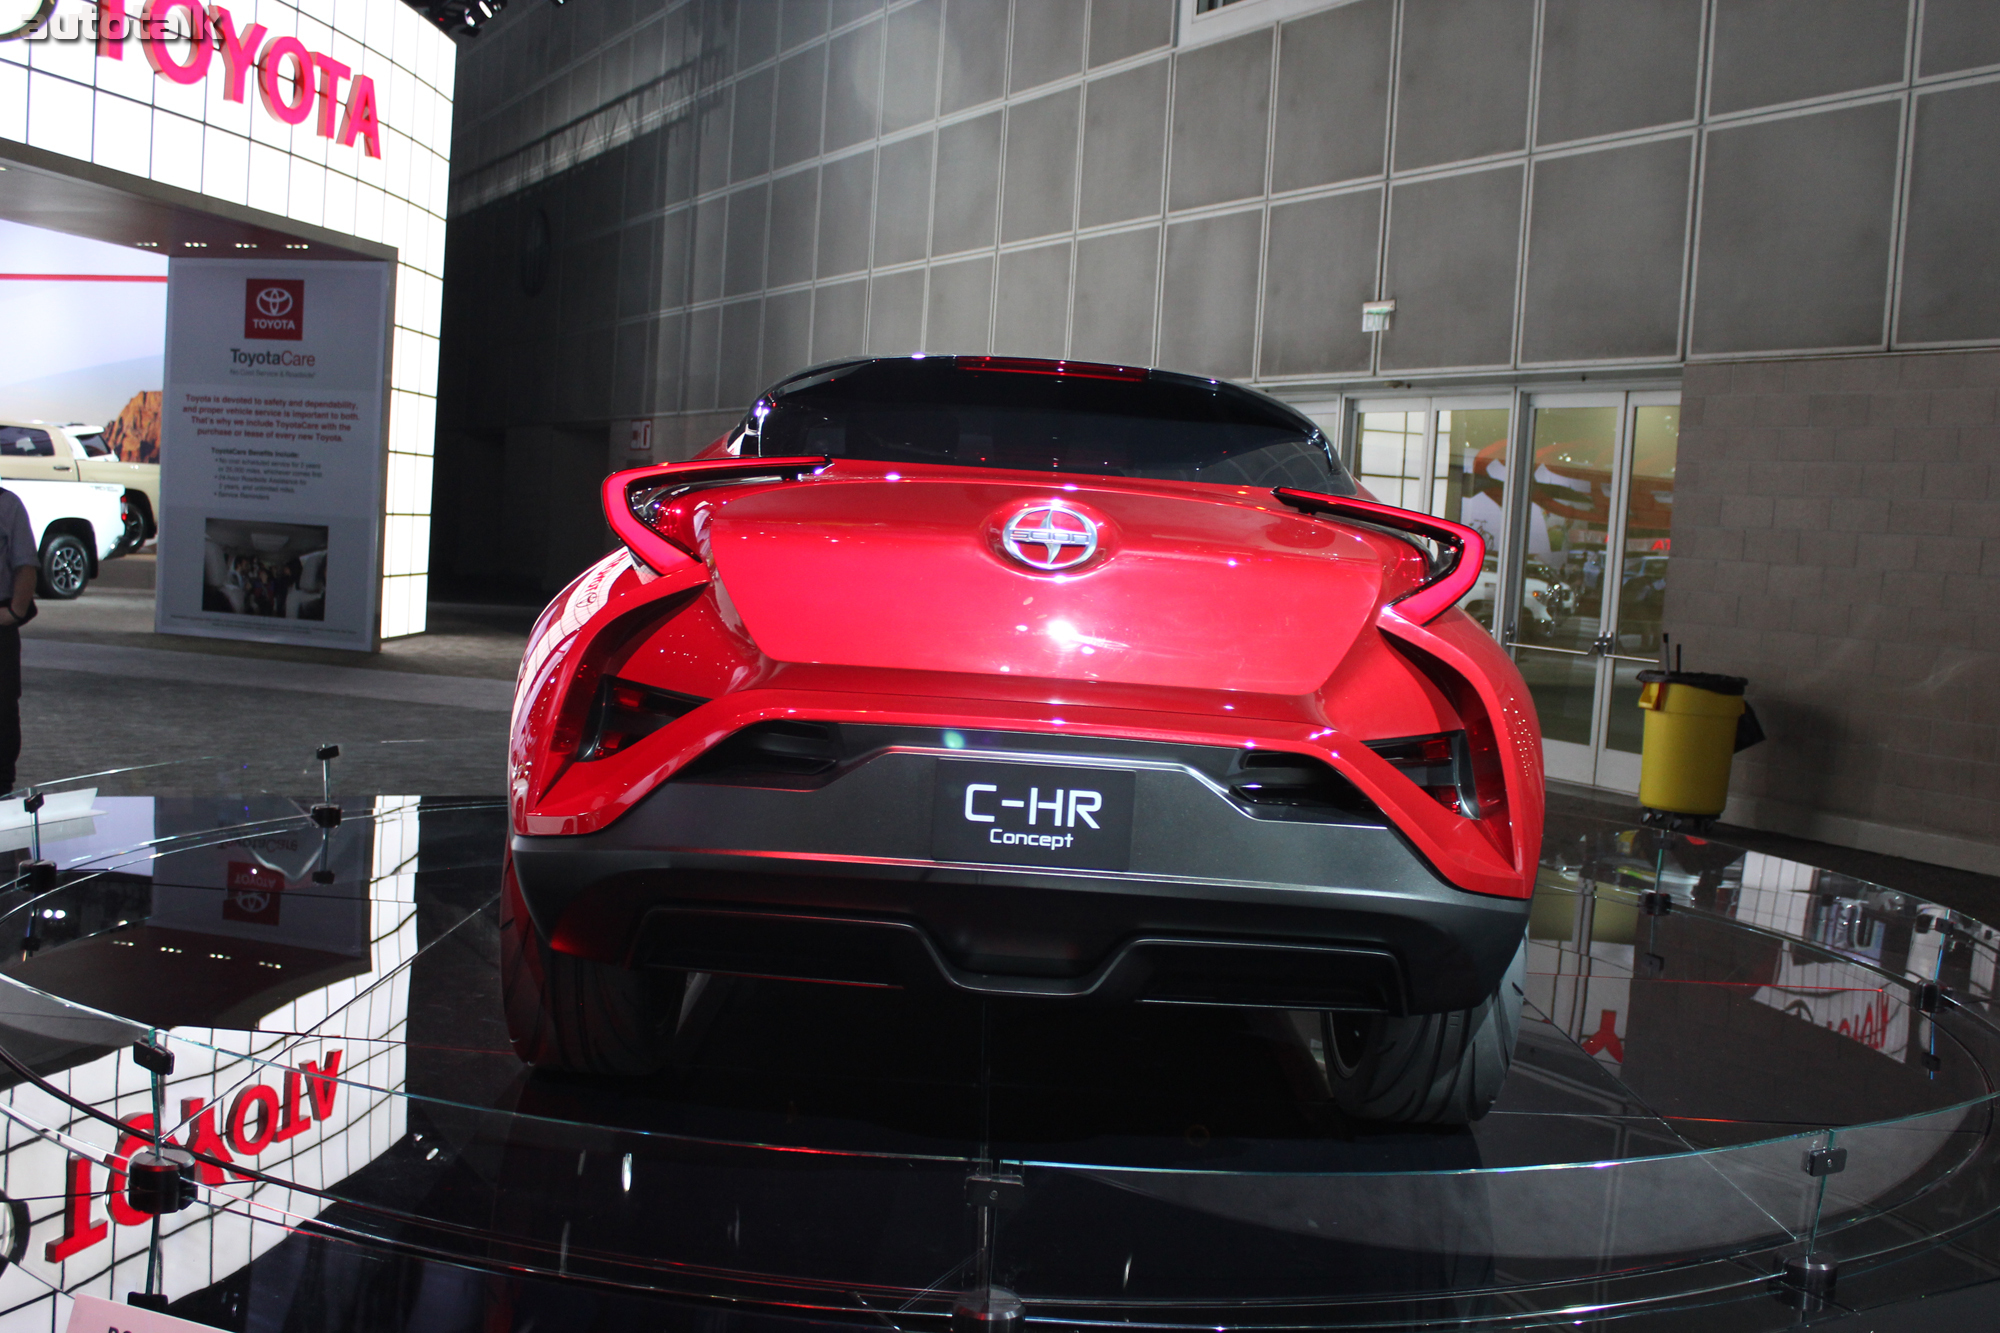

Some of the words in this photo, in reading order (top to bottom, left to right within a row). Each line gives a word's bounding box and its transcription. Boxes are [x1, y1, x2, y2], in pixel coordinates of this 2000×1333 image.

[252, 319, 296, 330] TOYOTA
[230, 348, 316, 367] ToyotaCare
[186, 394, 211, 403] Toyota
[222, 396, 252, 404] devoted
[264, 398, 286, 408] safety
[199, 407, 223, 415] proper
[226, 407, 253, 415] vehicle
[292, 410, 329, 419] important
[191, 416, 214, 424] That's
[216, 417, 231, 426] why
[246, 419, 273, 427] include
[276, 420, 319, 430] ToyotaCare
[339, 423, 351, 431] the
[197, 428, 232, 436] purchase
[275, 432, 296, 441] every
[211, 447, 246, 455] ToyotaCare
[965, 784, 1102, 829] C-HR
[990, 828, 1074, 850] Concept
